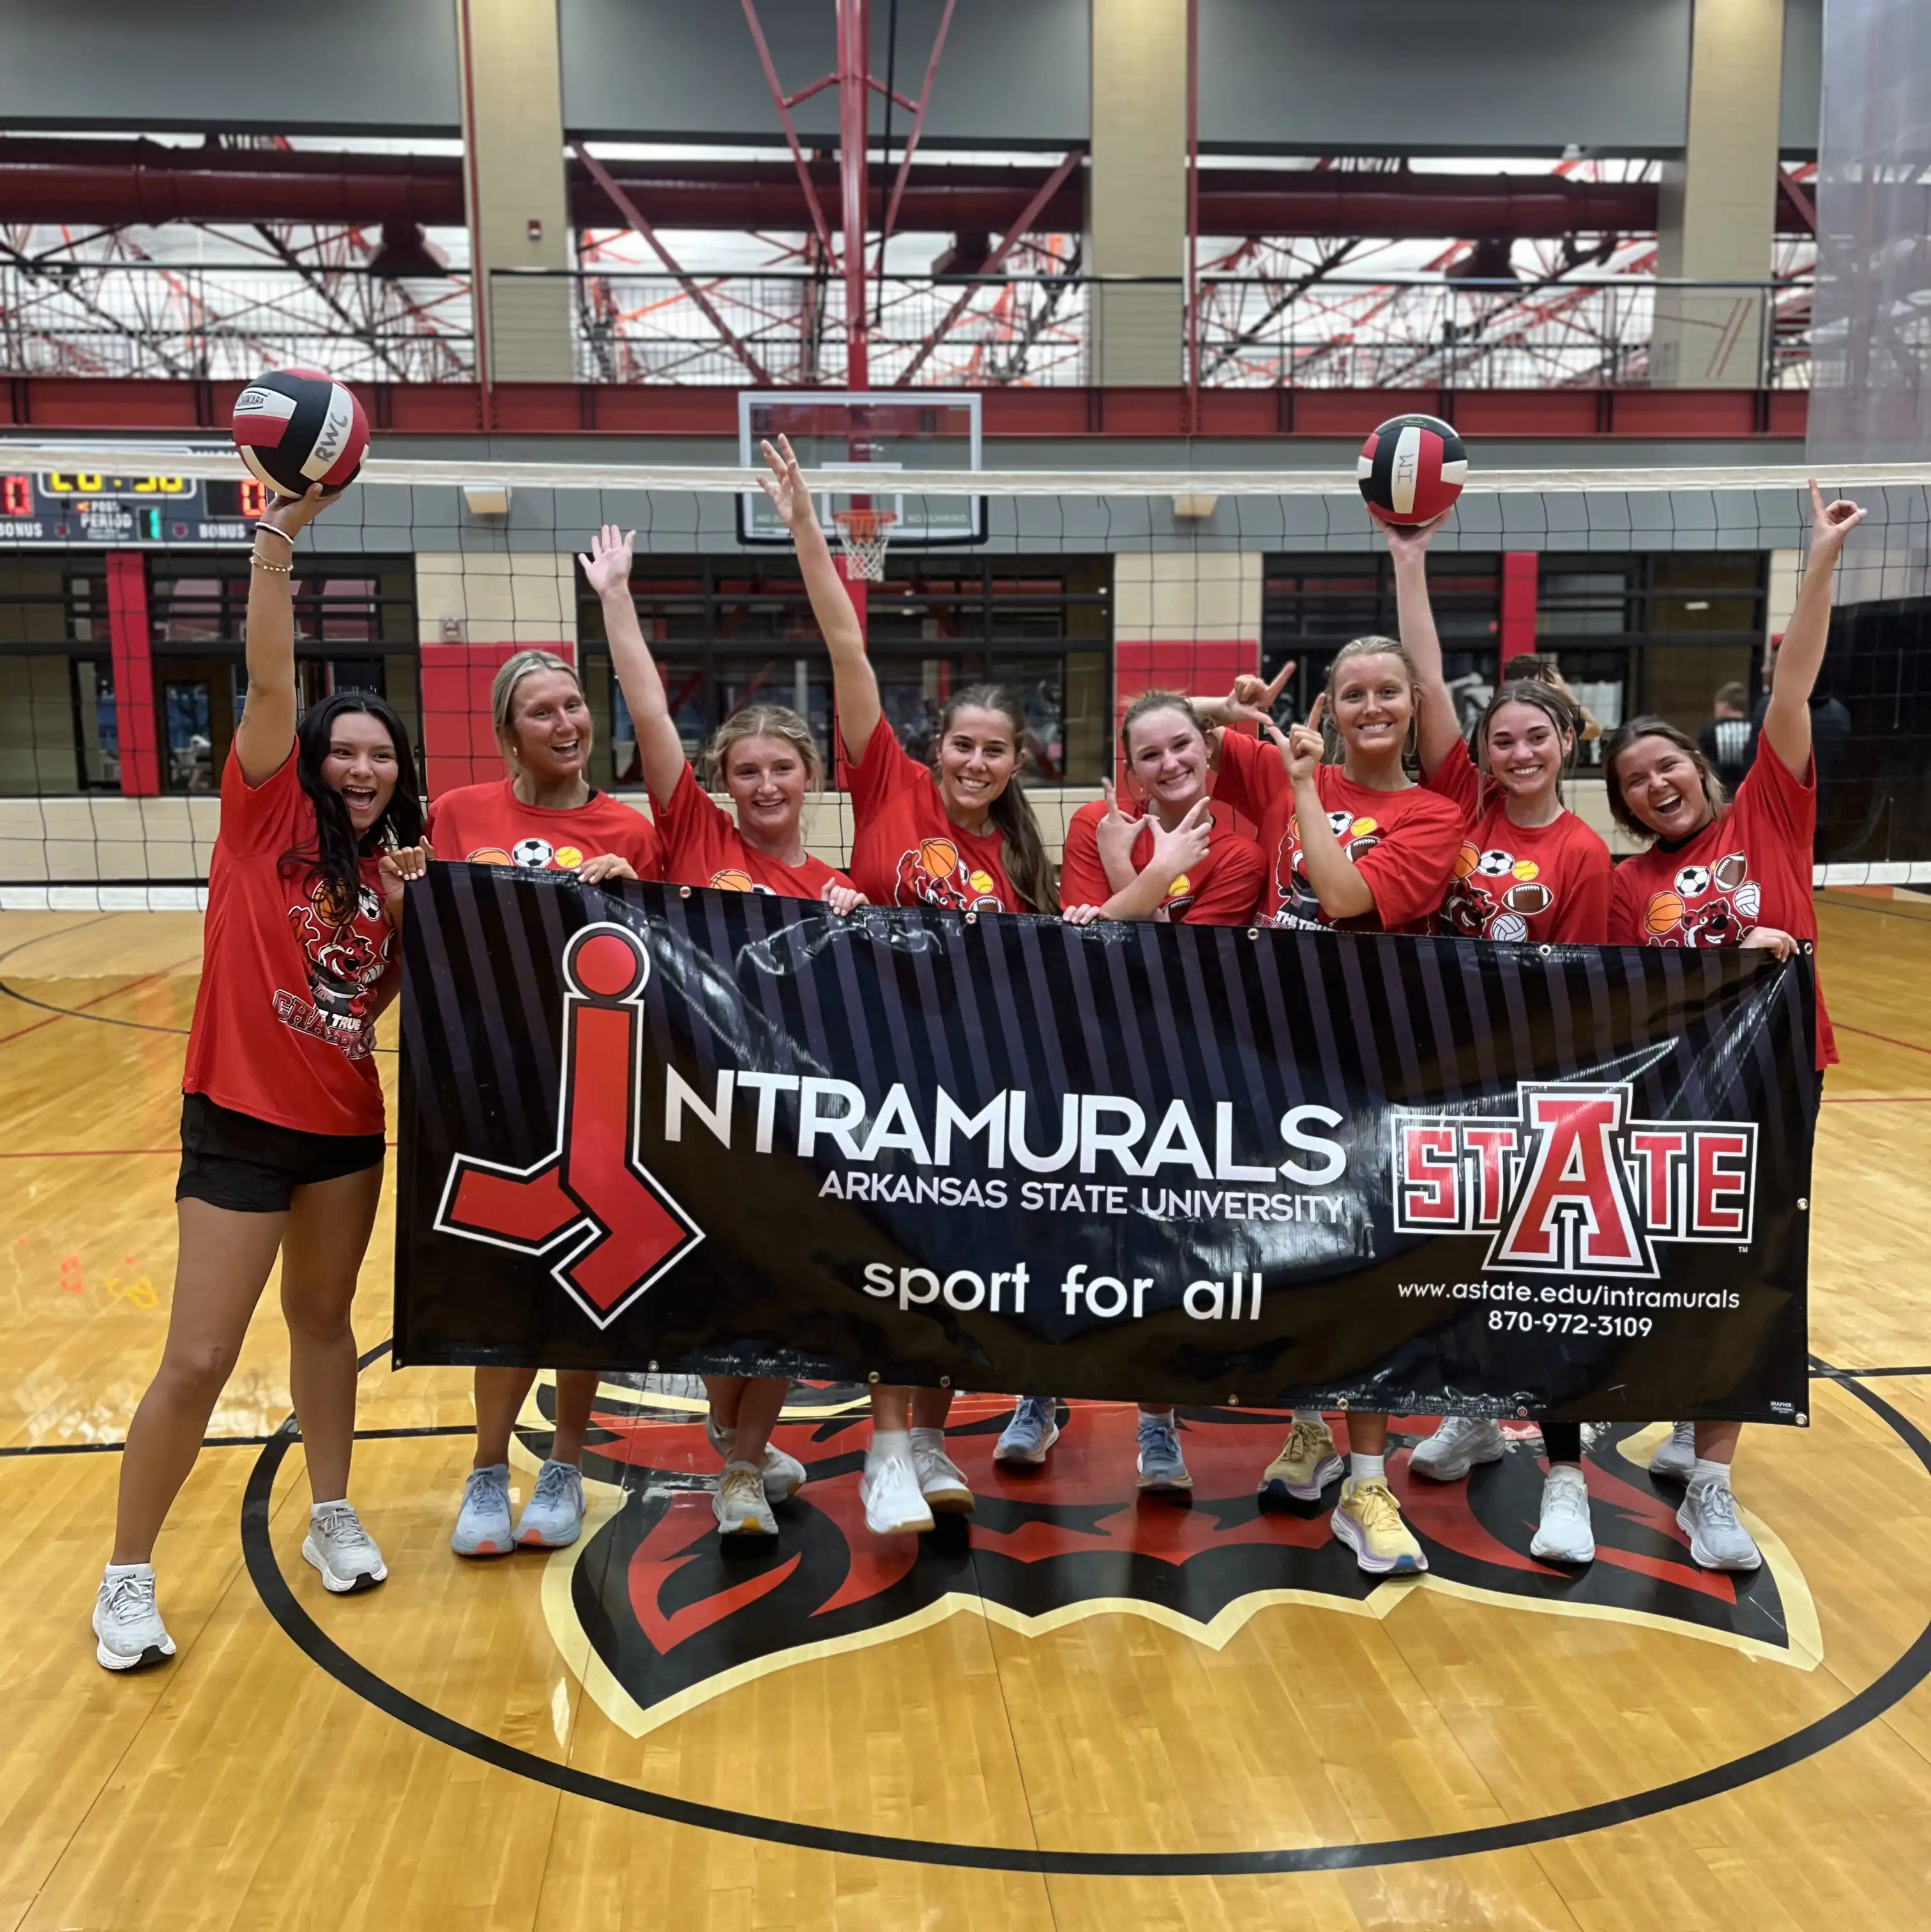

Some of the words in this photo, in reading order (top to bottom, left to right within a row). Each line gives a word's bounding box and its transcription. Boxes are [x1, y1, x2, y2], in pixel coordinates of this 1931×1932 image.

[314, 412, 349, 462] RWC
[80, 513, 133, 529] PERIOD
[199, 524, 246, 538] BONUS
[818, 1170, 1008, 1208] ARKANSAS
[1020, 1182, 1128, 1214] STATE
[1141, 1187, 1344, 1224] UNIVERSITY
[1401, 1091, 1750, 1268] STATE
[863, 1262, 1029, 1313] sport
[1061, 1264, 1154, 1318] for
[1183, 1271, 1262, 1320] all
[1398, 1280, 1740, 1308] www.astate.edu/intramurals
[1488, 1310, 1653, 1337] 870-972-3109
